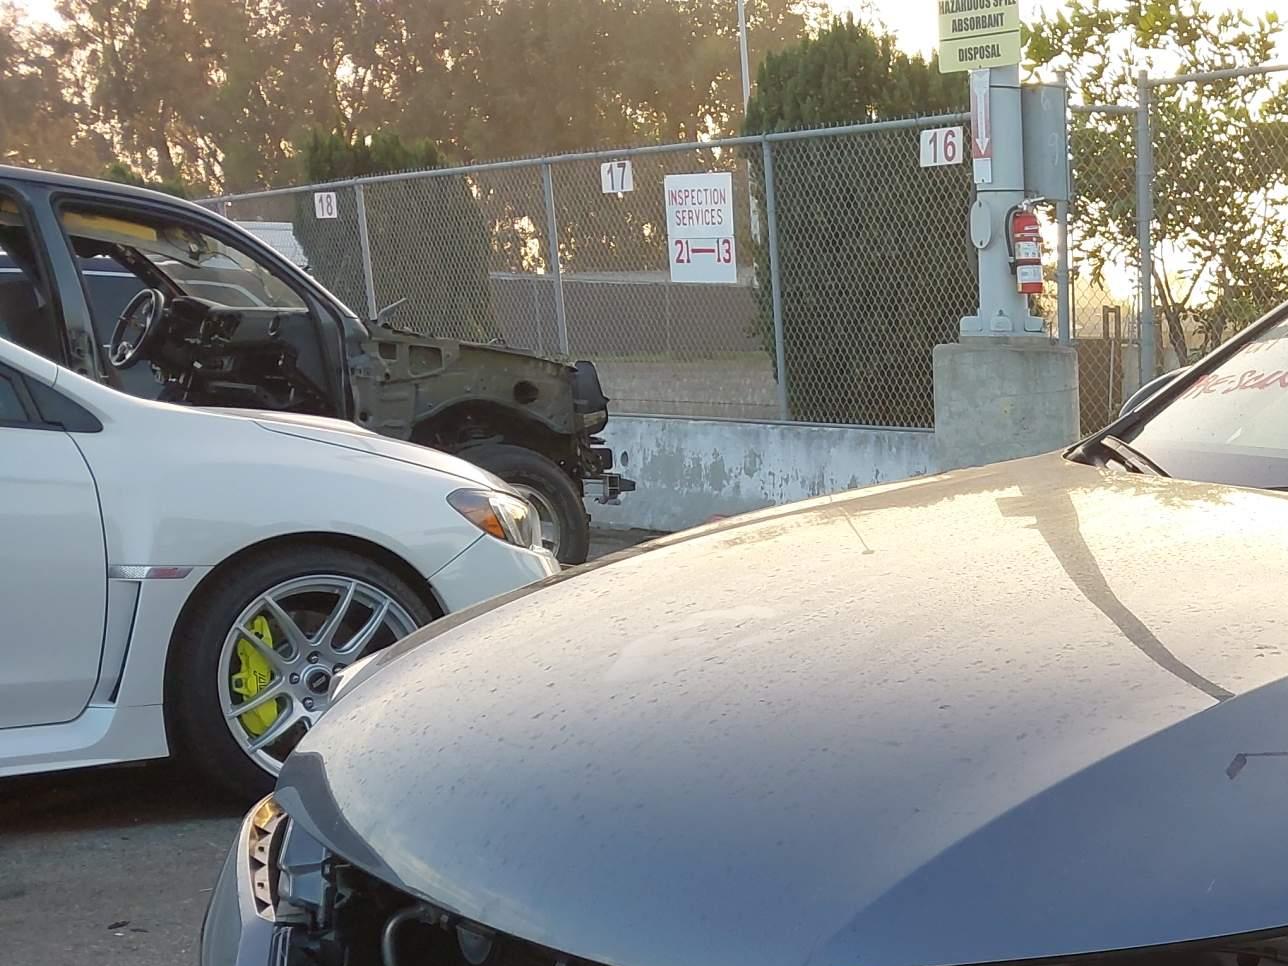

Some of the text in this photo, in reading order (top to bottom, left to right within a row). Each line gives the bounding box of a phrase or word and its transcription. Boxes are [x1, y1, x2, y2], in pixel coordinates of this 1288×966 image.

[951, 12, 1005, 33] ABSORBANT
[958, 43, 1001, 62] DISPOSAL
[928, 129, 957, 163] 16
[607, 162, 626, 191] 17
[319, 194, 333, 217] 18
[668, 188, 726, 206] INSPECTION
[675, 208, 723, 226] SERVICES
